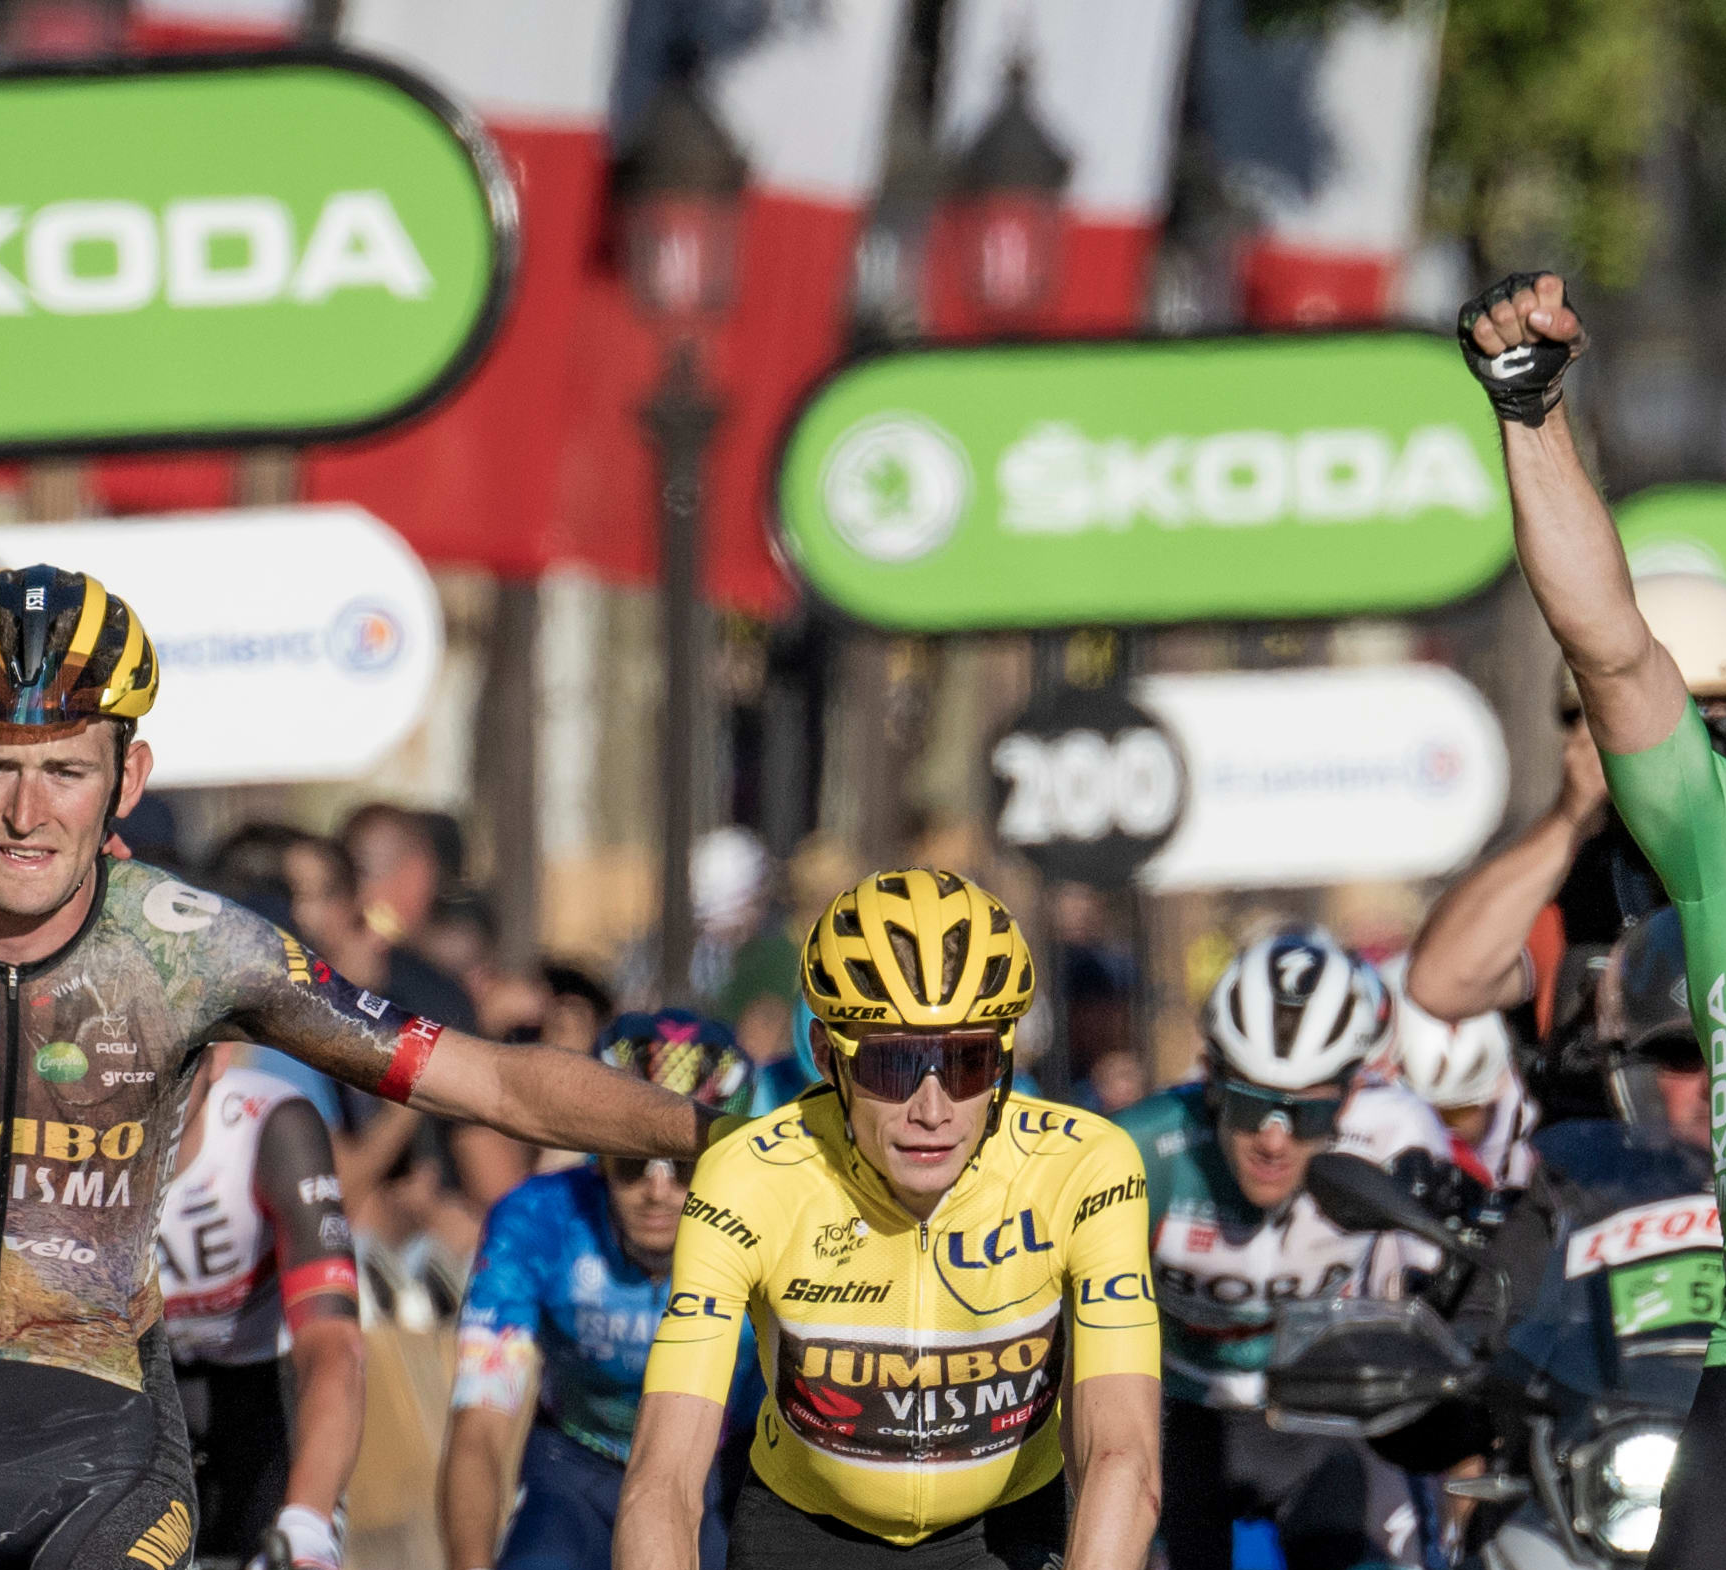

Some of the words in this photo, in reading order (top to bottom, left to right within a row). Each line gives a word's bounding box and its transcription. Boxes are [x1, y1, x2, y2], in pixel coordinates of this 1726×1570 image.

[995, 420, 1497, 535] ŠKODA
[992, 726, 1181, 845] 200
[828, 1005, 888, 1020] LAZER
[95, 1042, 138, 1054] AGU
[100, 1069, 156, 1087] graze
[1018, 1110, 1083, 1143] LCL
[948, 1208, 1054, 1270] LCL
[781, 1278, 894, 1304] Santini
[661, 1292, 732, 1321] CL
[795, 1336, 1050, 1390] JUMBO
[882, 1369, 1050, 1422] VISMA
[877, 1423, 971, 1439] cervélo
[970, 1435, 1016, 1456] graze
